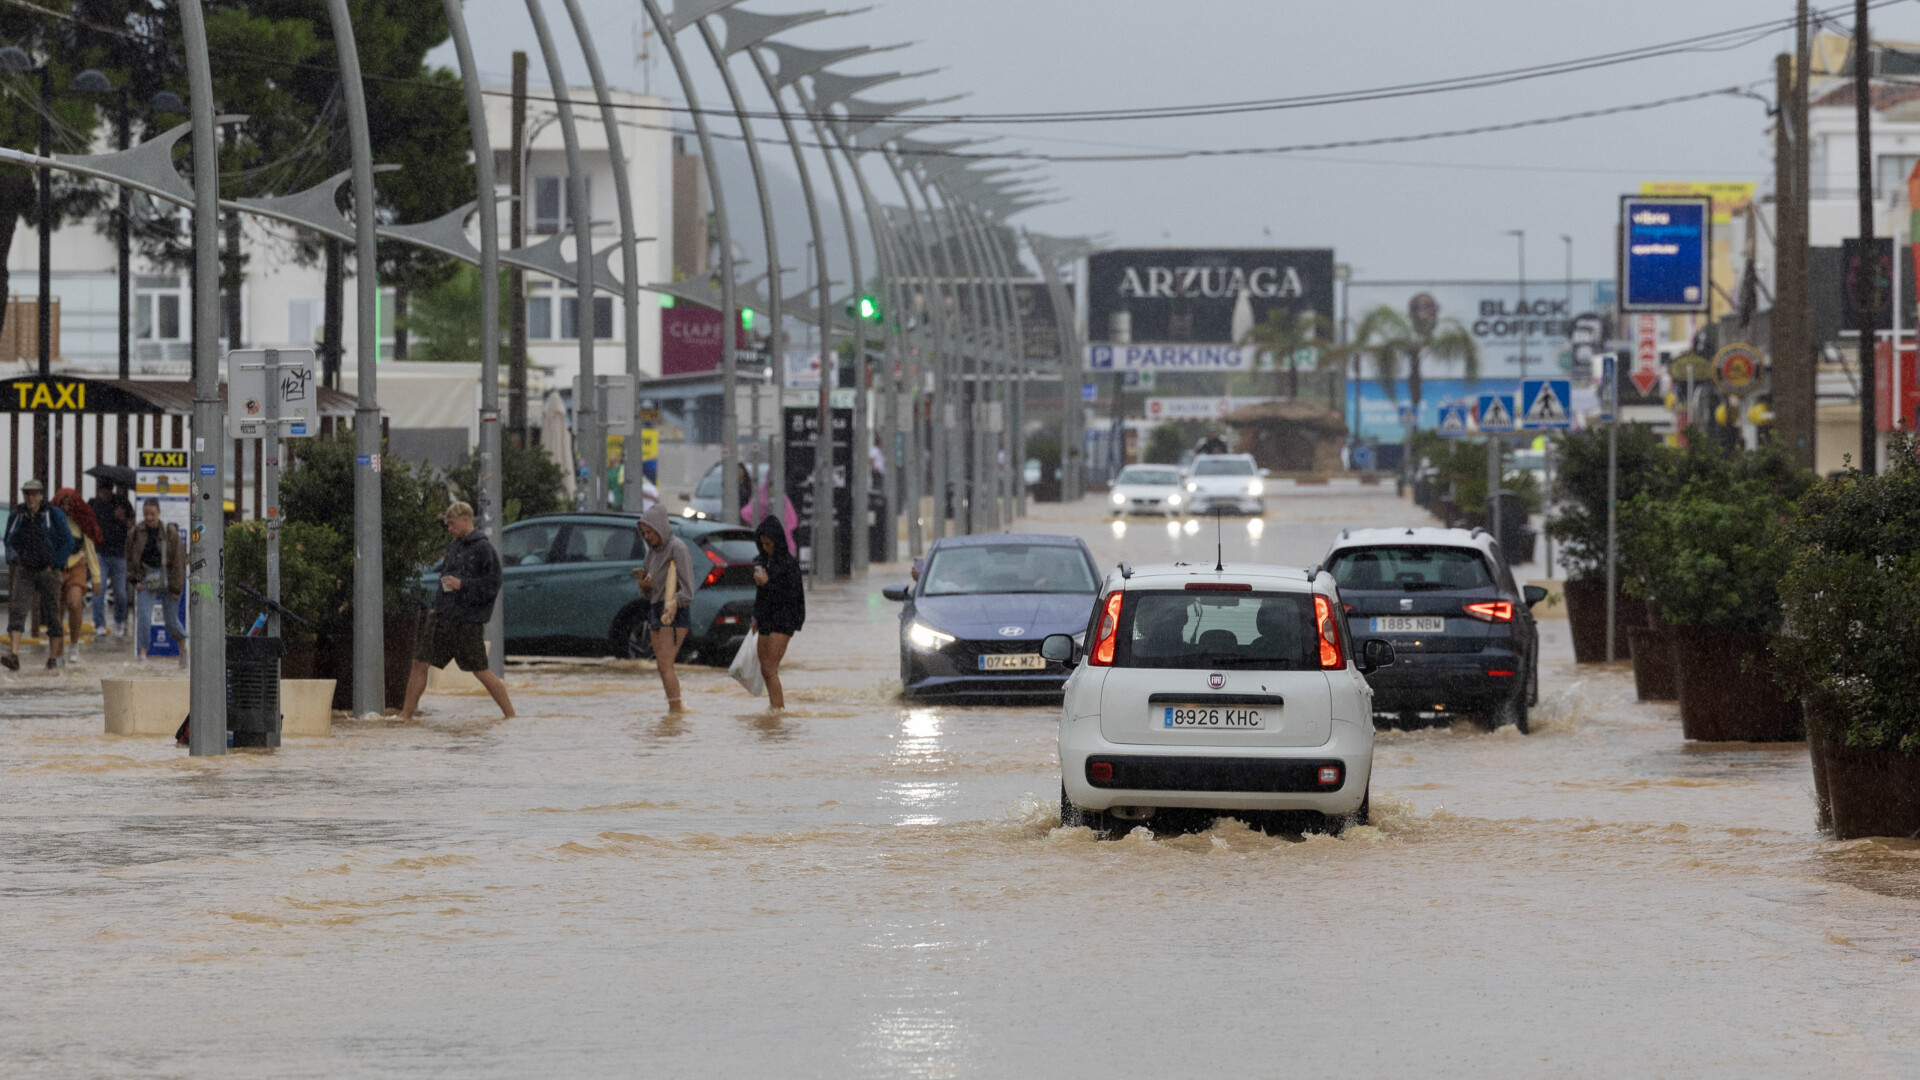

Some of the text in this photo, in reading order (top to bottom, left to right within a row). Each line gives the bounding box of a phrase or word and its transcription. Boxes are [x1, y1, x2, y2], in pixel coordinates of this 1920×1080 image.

[1119, 266, 1303, 298] ARZUAGA
[1480, 300, 1569, 316] BLACK
[1126, 348, 1242, 366] PARKING
[13, 382, 85, 409] TAXI
[142, 452, 184, 466] TAXI
[1382, 619, 1440, 630] 1885 NBW
[986, 656, 1017, 668] 0744
[1211, 676, 1222, 684] FIAT
[1174, 709, 1219, 726] 8926
[1225, 709, 1259, 726] KHC
